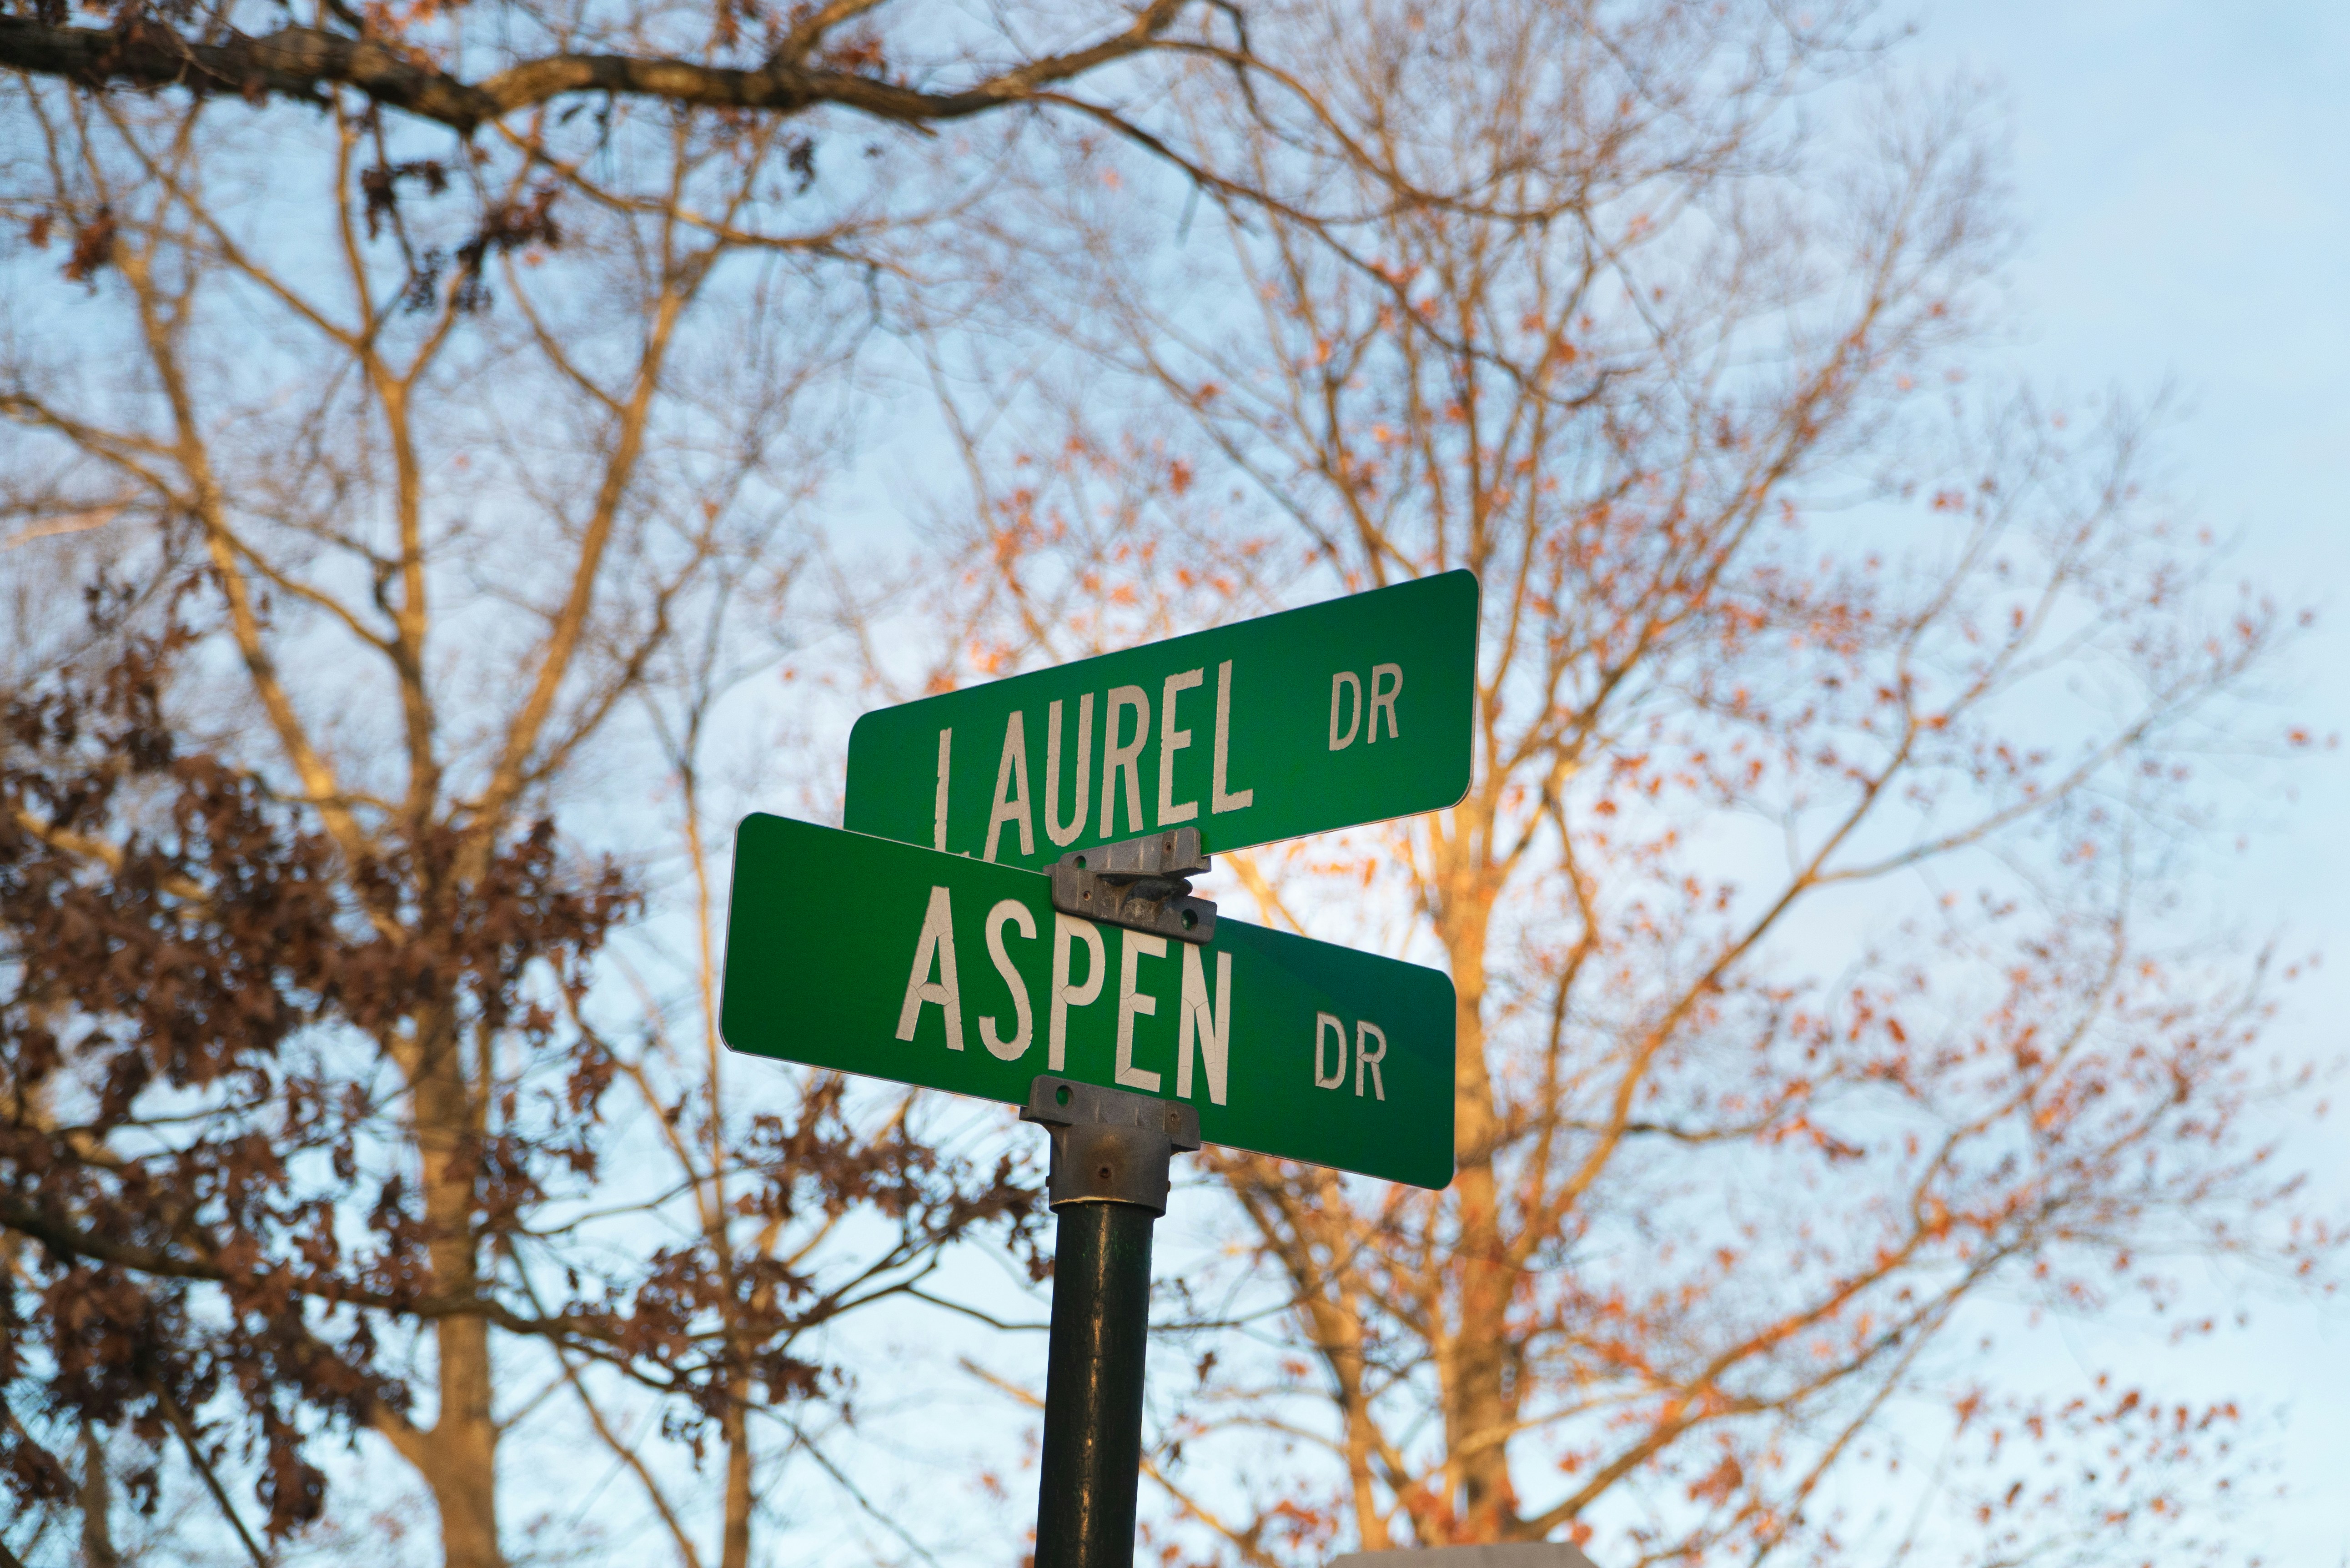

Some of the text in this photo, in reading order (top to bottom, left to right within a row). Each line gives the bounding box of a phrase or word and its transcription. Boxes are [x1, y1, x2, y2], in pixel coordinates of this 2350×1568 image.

[934, 659, 1403, 863] LAUREL DR
[895, 885, 1386, 1106] ASPEN DR
